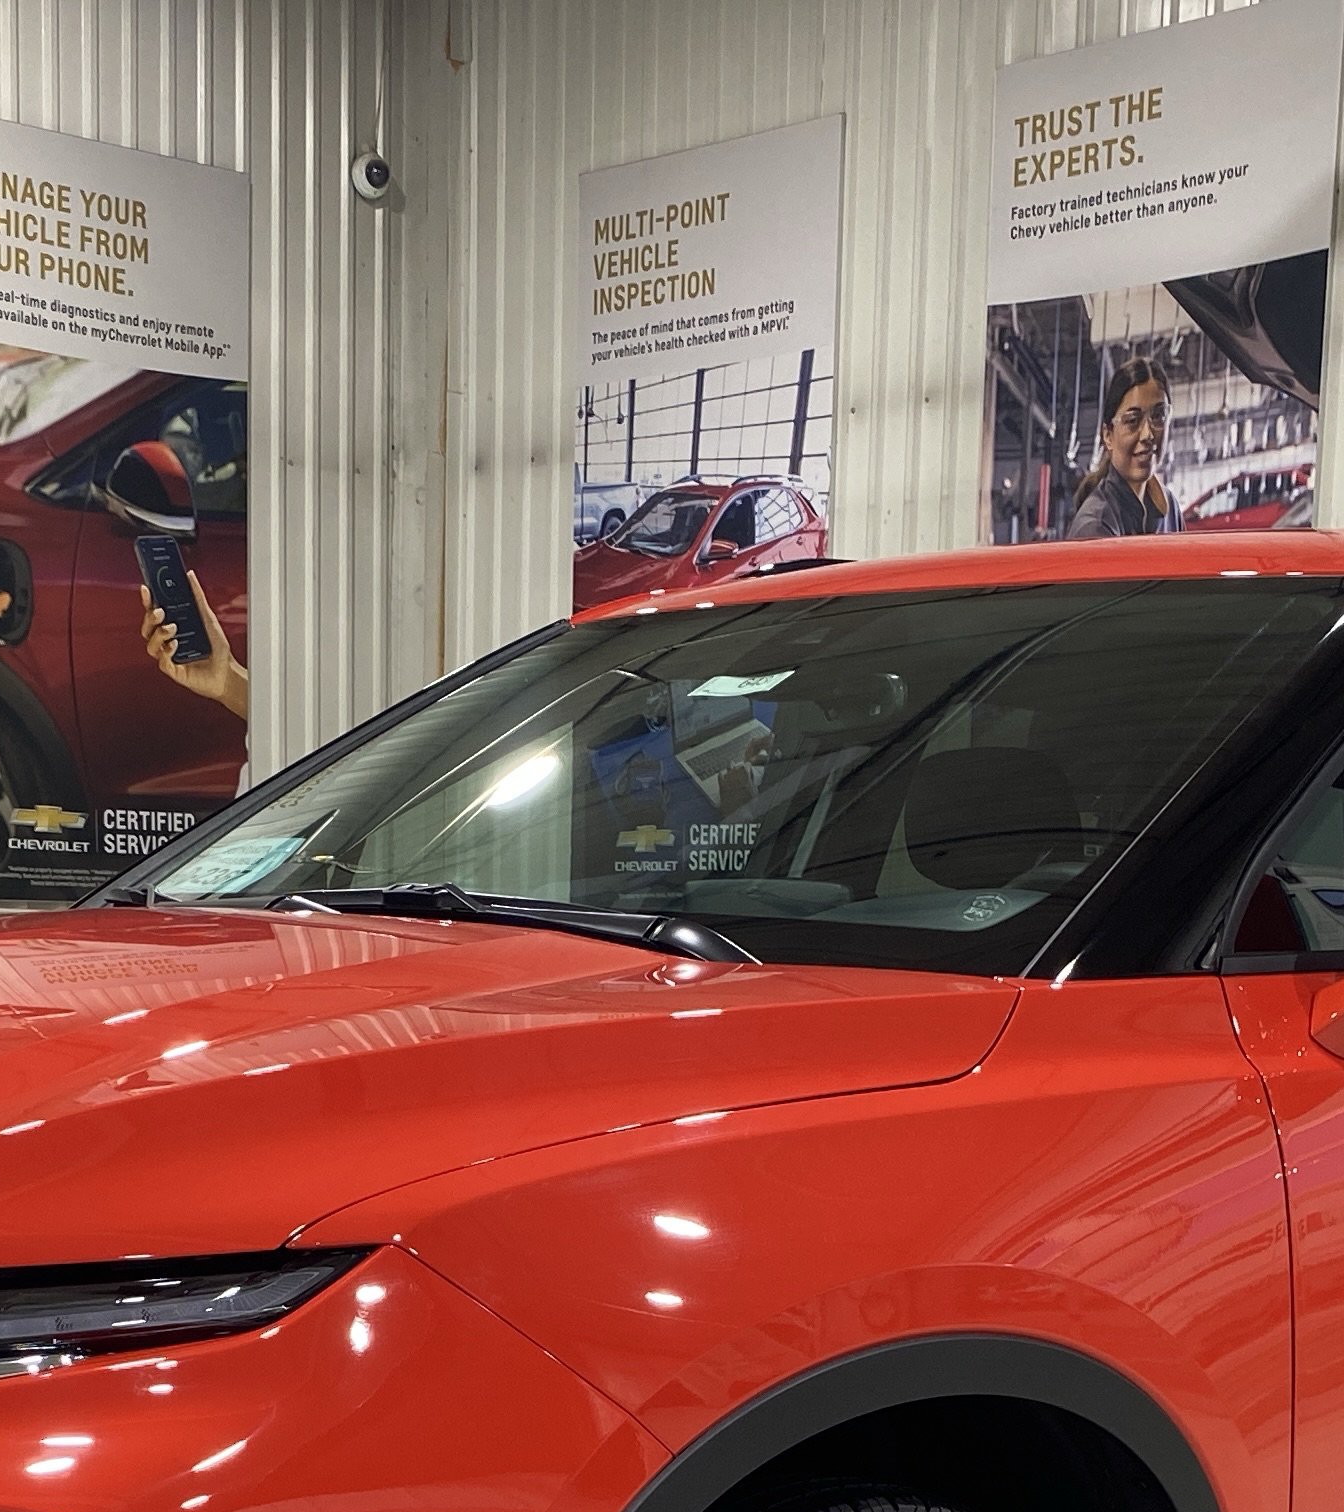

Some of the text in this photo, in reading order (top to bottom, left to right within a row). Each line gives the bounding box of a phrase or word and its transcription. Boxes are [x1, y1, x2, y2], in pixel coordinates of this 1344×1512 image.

[1014, 87, 1163, 148] TRUST THE
[1013, 135, 1144, 188] EXPERTS.
[80, 190, 147, 229] YOUR
[1011, 163, 1250, 221] Factory trained technicians know your
[594, 192, 730, 246] MULTI-POINT
[1010, 194, 1218, 241] Chevy vehicle better than anyone.
[79, 225, 149, 264] FROM
[593, 239, 679, 280] VEHICLE
[40, 252, 134, 297] PHONE.
[593, 268, 716, 316] INSPECTION
[50, 299, 116, 324] diagnostics
[119, 313, 140, 328] and
[142, 318, 172, 335] enjoy
[175, 323, 214, 339] remote
[51, 319, 66, 332] on
[68, 321, 88, 336] the
[91, 326, 162, 350] myChevrolet
[165, 338, 200, 355] Mobile
[592, 298, 795, 345] The peace of mind that comes from getting
[591, 350, 611, 366] your
[613, 340, 653, 359] vehicle's
[654, 335, 685, 354] health
[686, 330, 726, 348] checked
[728, 324, 750, 340] with
[752, 324, 759, 337] a
[7, 837, 90, 853] CHEVROLET
[689, 823, 761, 845] CERTIFIE
[614, 860, 678, 872] CHEVROLET
